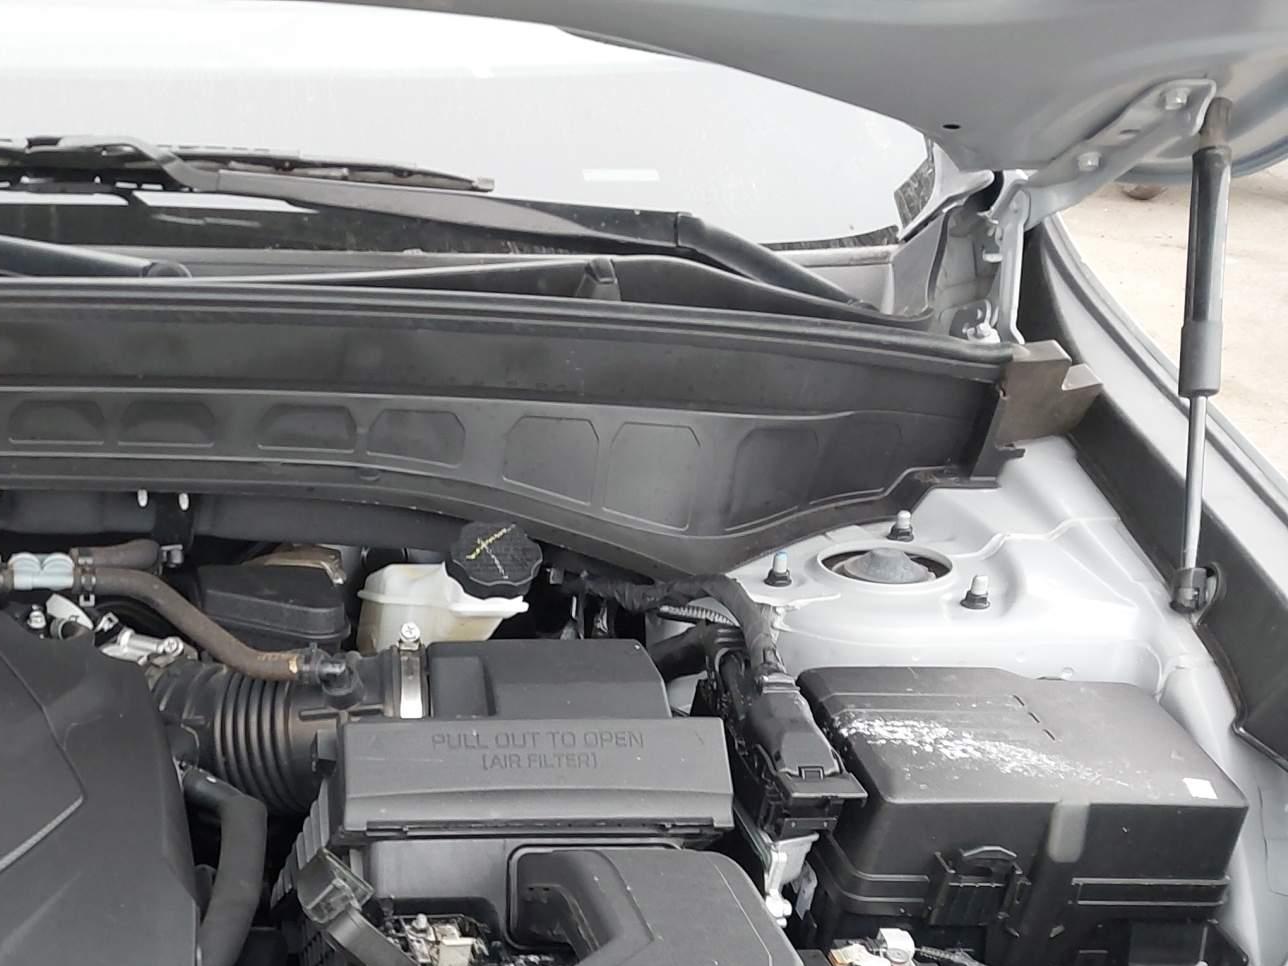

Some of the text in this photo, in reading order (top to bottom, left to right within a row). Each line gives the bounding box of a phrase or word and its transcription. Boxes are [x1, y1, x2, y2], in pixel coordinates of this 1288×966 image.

[432, 731, 644, 750] PULL OUT TO OPEN
